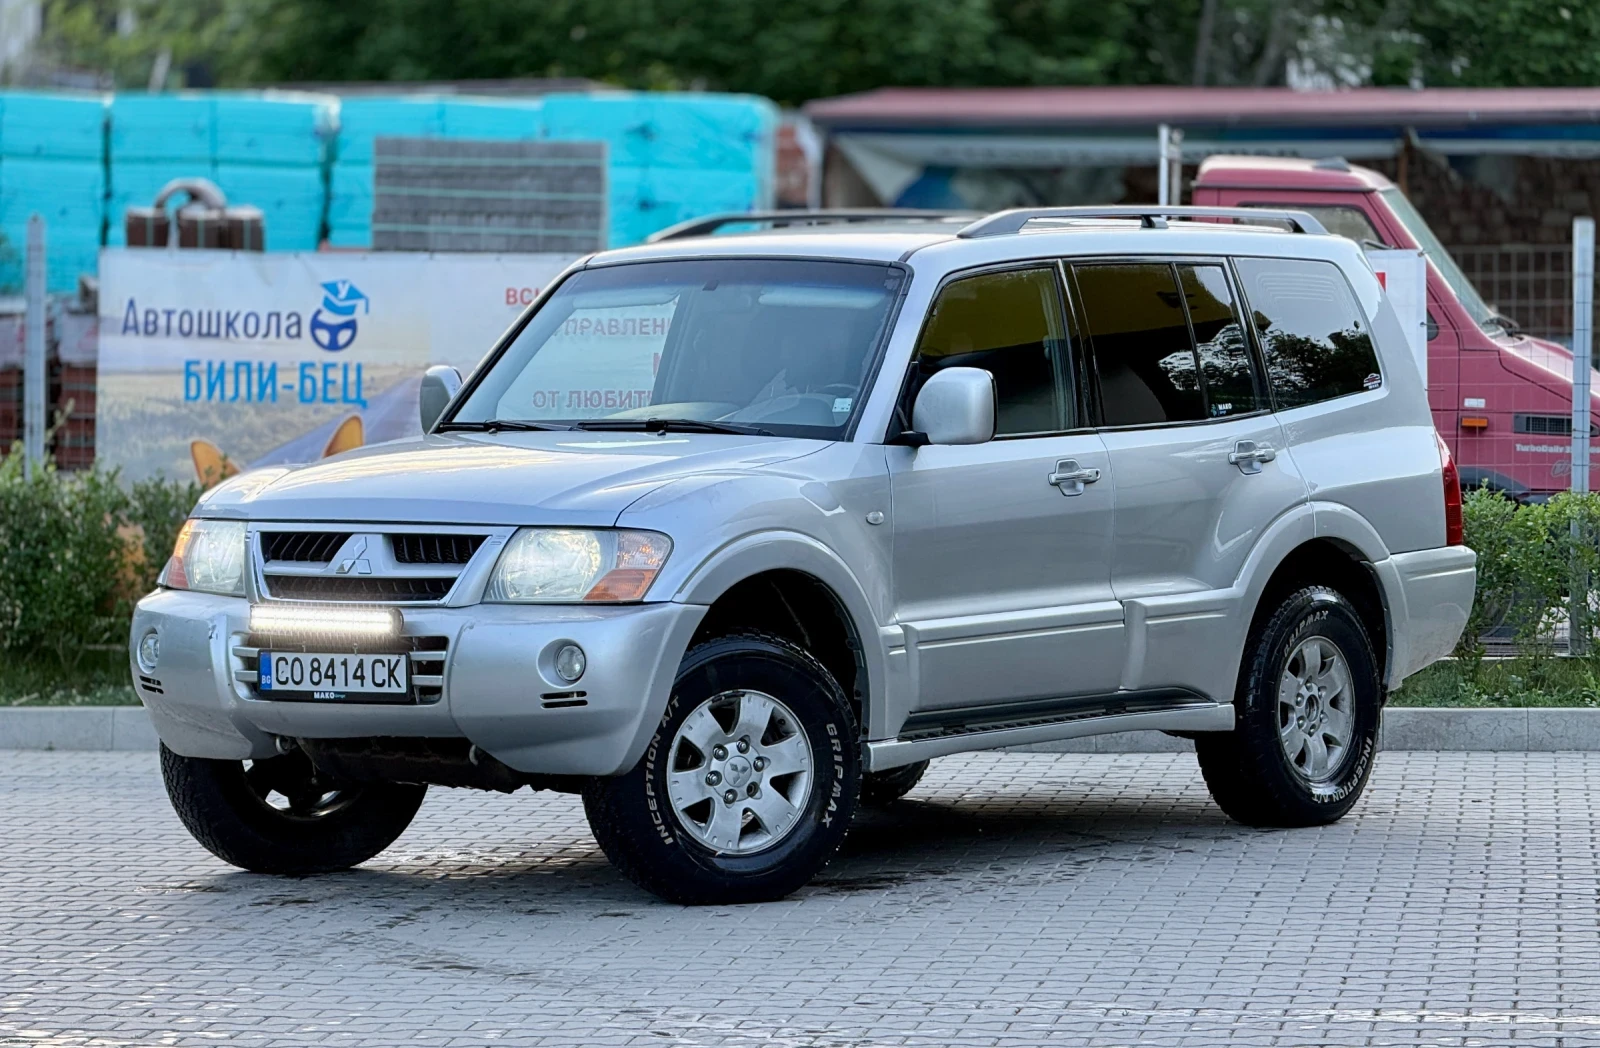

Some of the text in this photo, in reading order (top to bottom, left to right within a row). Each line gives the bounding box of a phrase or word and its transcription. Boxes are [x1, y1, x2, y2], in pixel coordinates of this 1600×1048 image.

[122, 297, 303, 339] Автошкола
[554, 317, 671, 337] ПРАВЛЕН
[184, 360, 368, 408] БИЛИ-БЕЦ
[532, 390, 560, 409] ОТ
[261, 674, 271, 684] BG
[275, 656, 402, 688] CO 8414 CK
[313, 691, 335, 699] MAKO
[645, 695, 680, 845] INCEPTION A/T
[822, 722, 844, 828] GRIPMAX
[1332, 736, 1373, 802] INCEPTION
